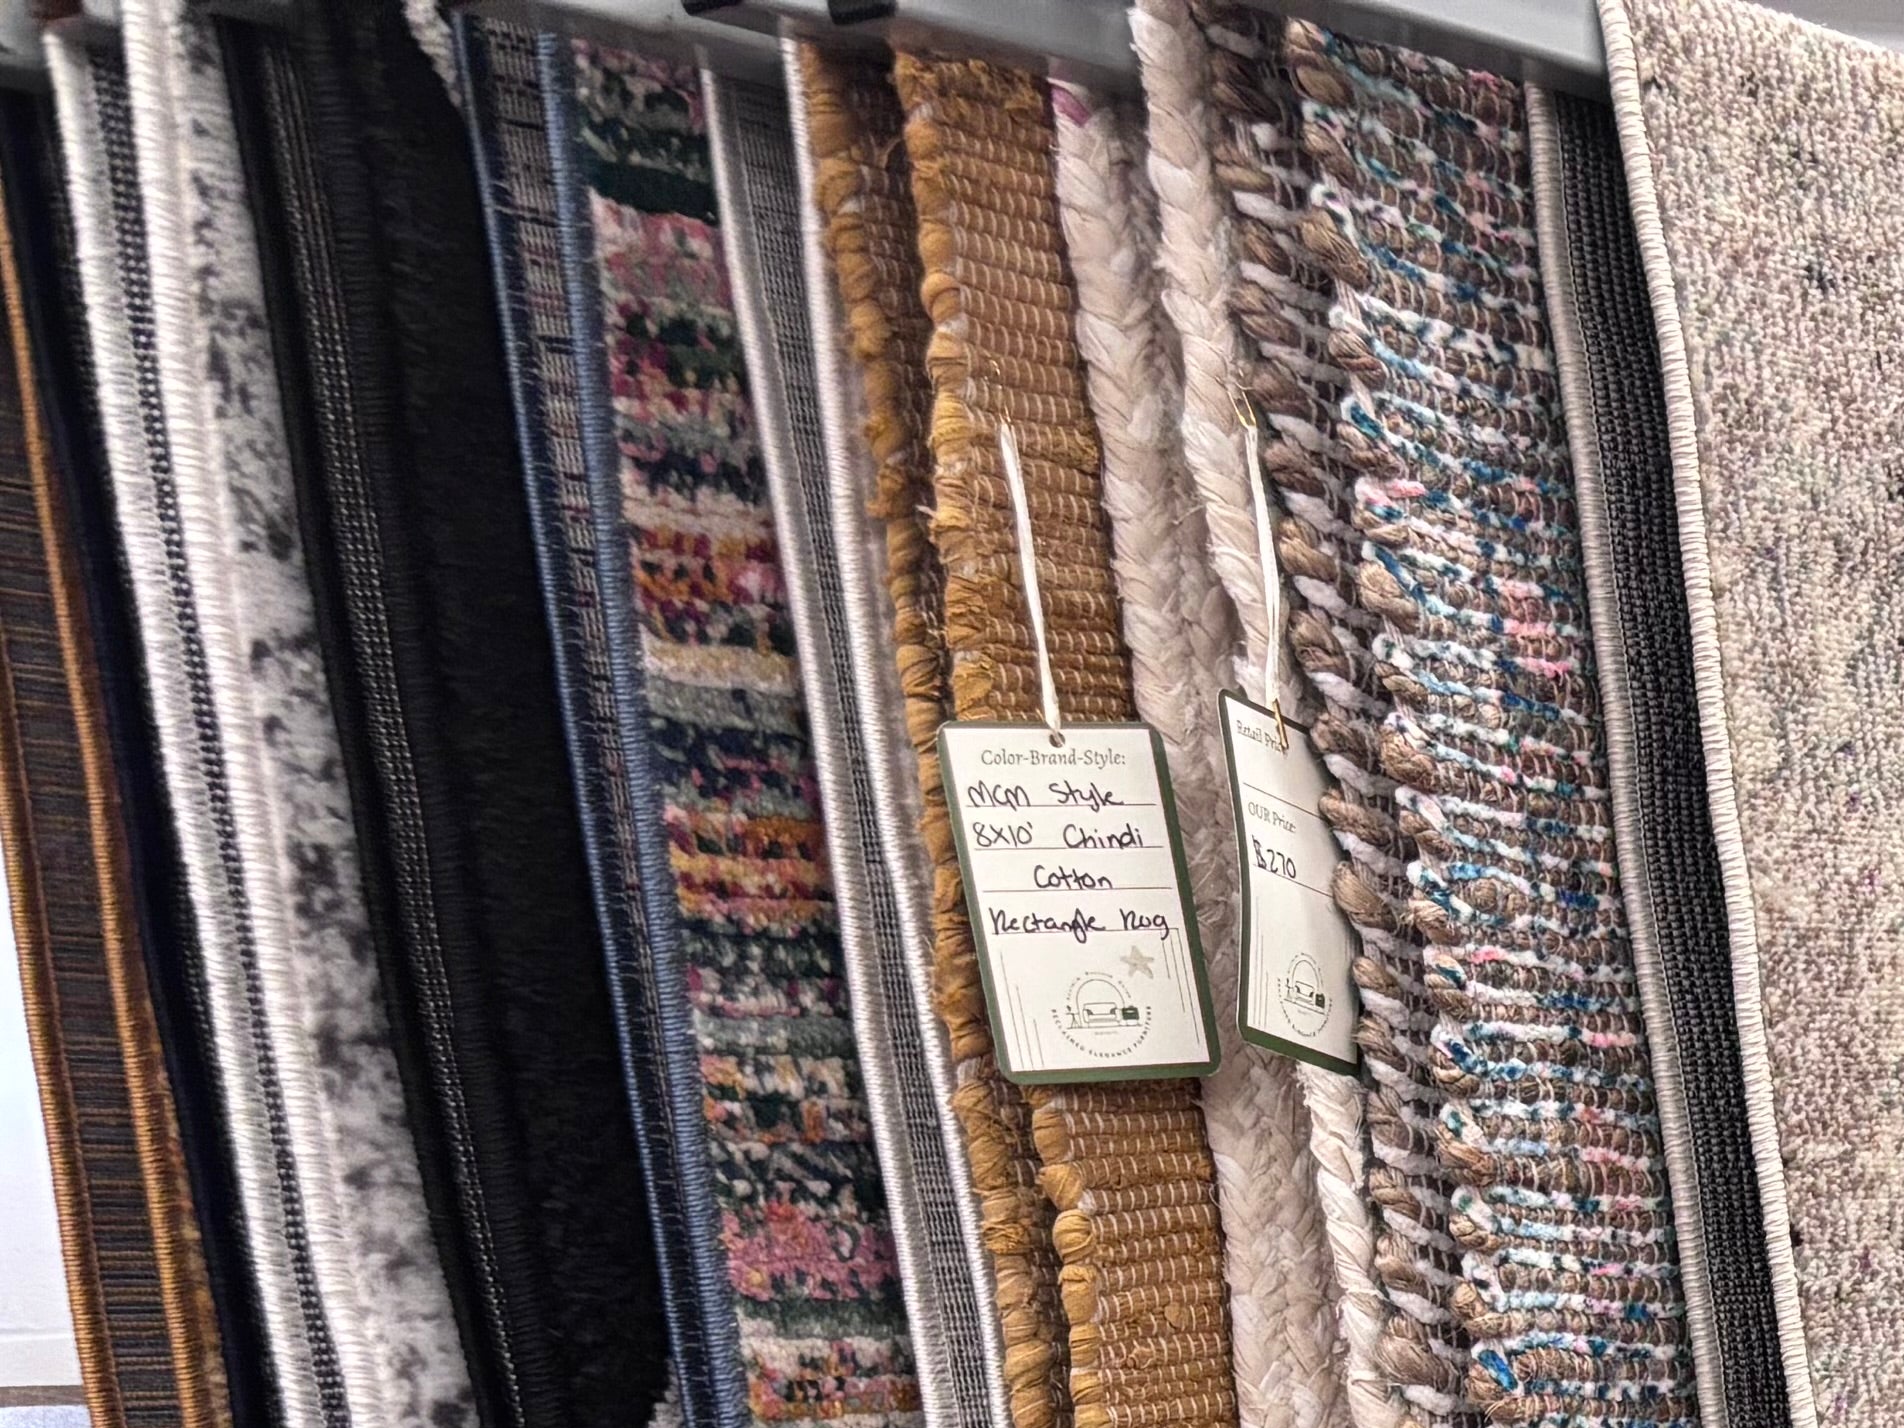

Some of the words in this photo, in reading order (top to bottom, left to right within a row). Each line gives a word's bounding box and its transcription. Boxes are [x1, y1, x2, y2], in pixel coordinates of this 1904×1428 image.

[981, 748, 1126, 769] Color-Brand-Style:
[1048, 780, 1125, 812] Style
[1248, 801, 1271, 824] OUR
[1062, 823, 1144, 850] Chindi
[1252, 834, 1297, 879] $270
[1033, 864, 1114, 889] Cotton
[988, 907, 1107, 944] Rectangle
[1119, 908, 1170, 941] Rug
